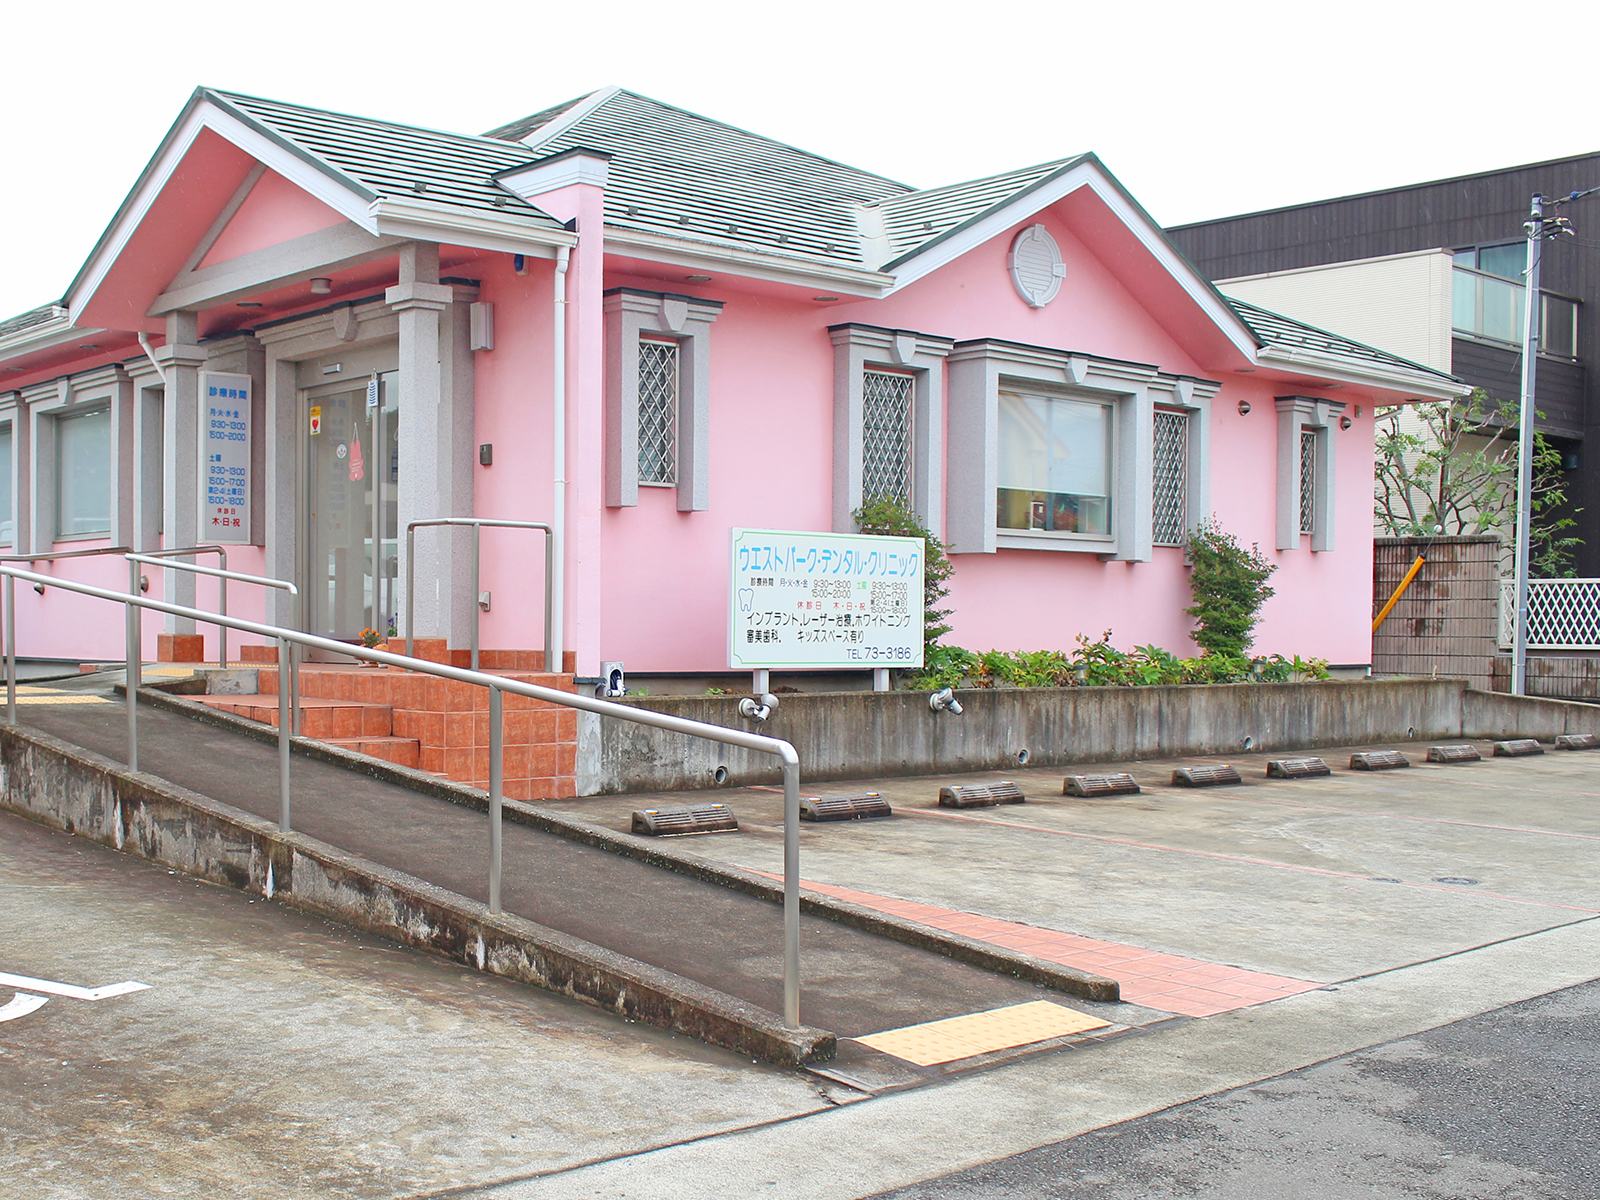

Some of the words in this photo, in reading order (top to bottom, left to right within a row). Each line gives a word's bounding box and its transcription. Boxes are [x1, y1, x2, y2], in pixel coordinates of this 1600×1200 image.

[209, 386, 247, 400] 診療時間
[739, 545, 918, 577] ウエストパーク・デンタル・クリニック
[750, 577, 774, 587] 診療時間
[797, 629, 864, 644] キッズスペース有り
[846, 648, 862, 660] TEL
[864, 647, 911, 660] 73-3186
